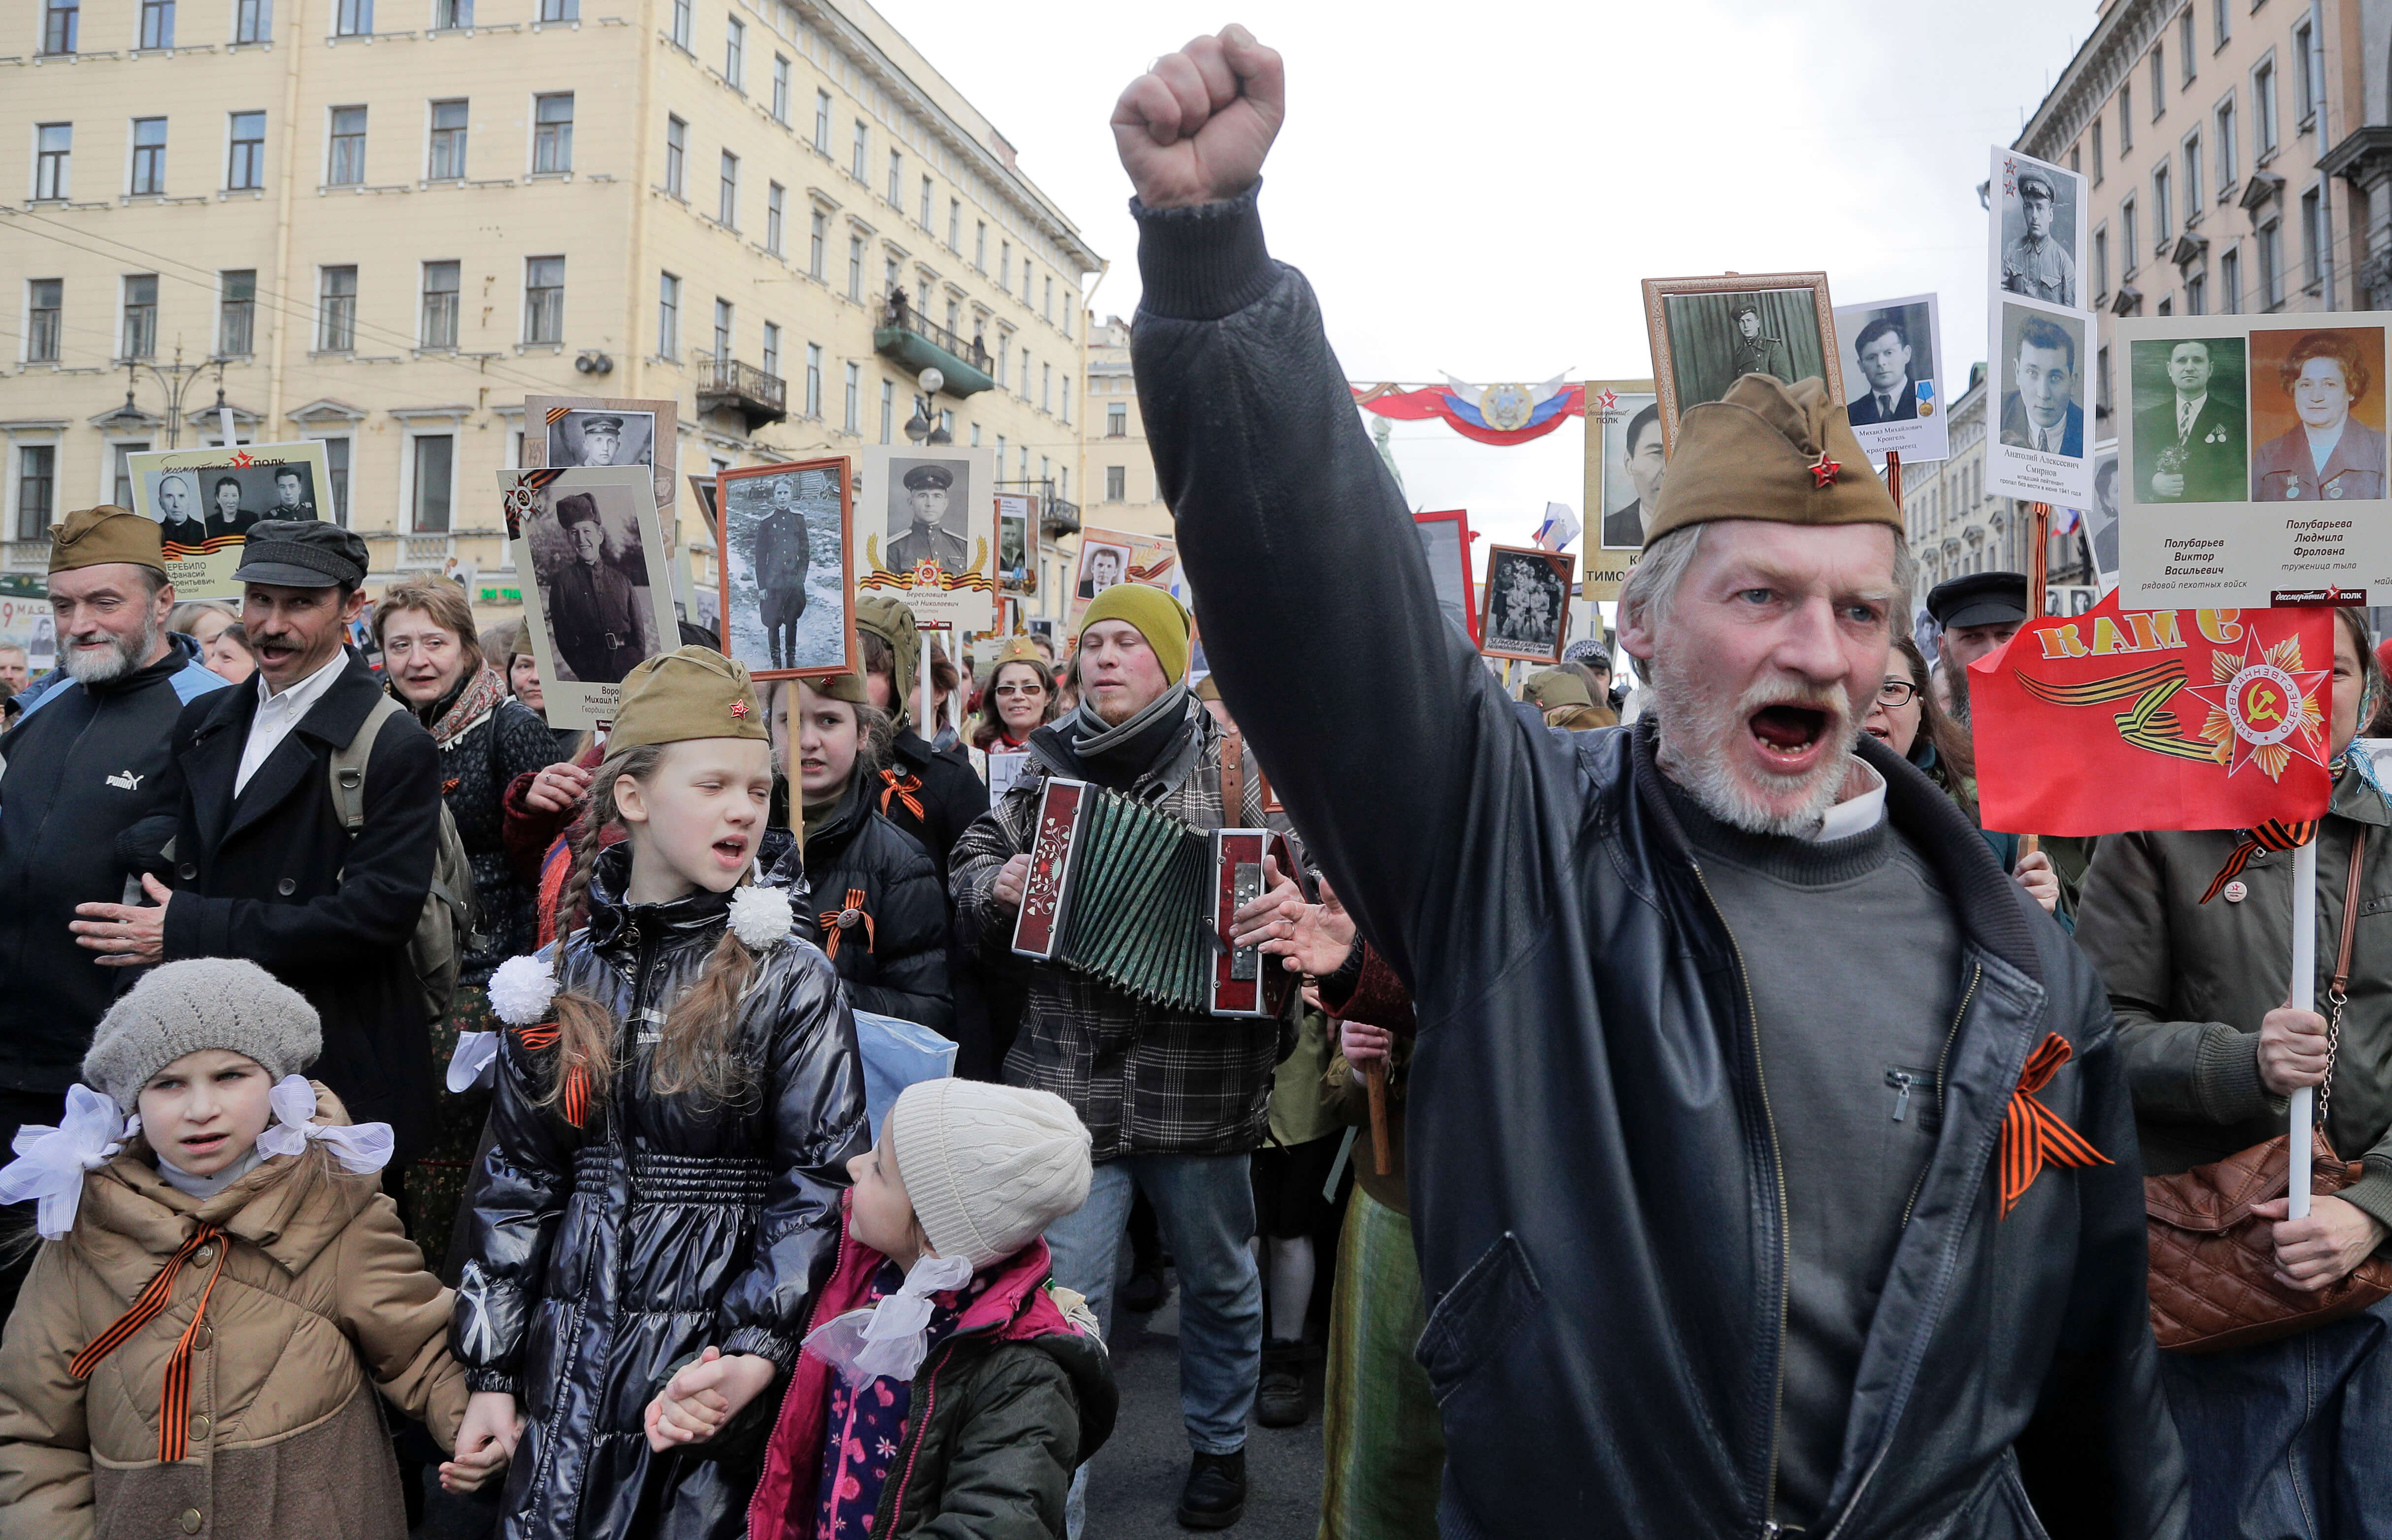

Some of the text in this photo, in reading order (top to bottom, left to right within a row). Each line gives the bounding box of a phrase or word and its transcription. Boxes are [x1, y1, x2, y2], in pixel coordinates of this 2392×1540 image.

[1885, 425, 1923, 433] Михайлович
[1866, 444, 1917, 454] красноармеец
[254, 458, 286, 468] ПОЛК
[2004, 449, 2079, 469] Анатолий Алексеевич
[2026, 464, 2057, 477] Смирнов
[2286, 520, 2353, 530] Полубарьева
[2294, 533, 2343, 542] Людмила
[2164, 538, 2225, 550] Полубарьев
[2174, 552, 2215, 562] Виктор
[2293, 547, 2345, 558] Фроловна
[2165, 566, 2224, 575] Васильевич
[2282, 563, 2330, 572] труженица
[1586, 571, 1625, 582] ТИМО
[172, 579, 215, 587] арентьевич
[2141, 581, 2176, 591] рядовой
[3, 603, 14, 628] 9
[602, 686, 619, 696] Воро
[584, 695, 612, 704] Михаил
[582, 705, 605, 715] Гвардии
[106, 775, 133, 790] PUMA
